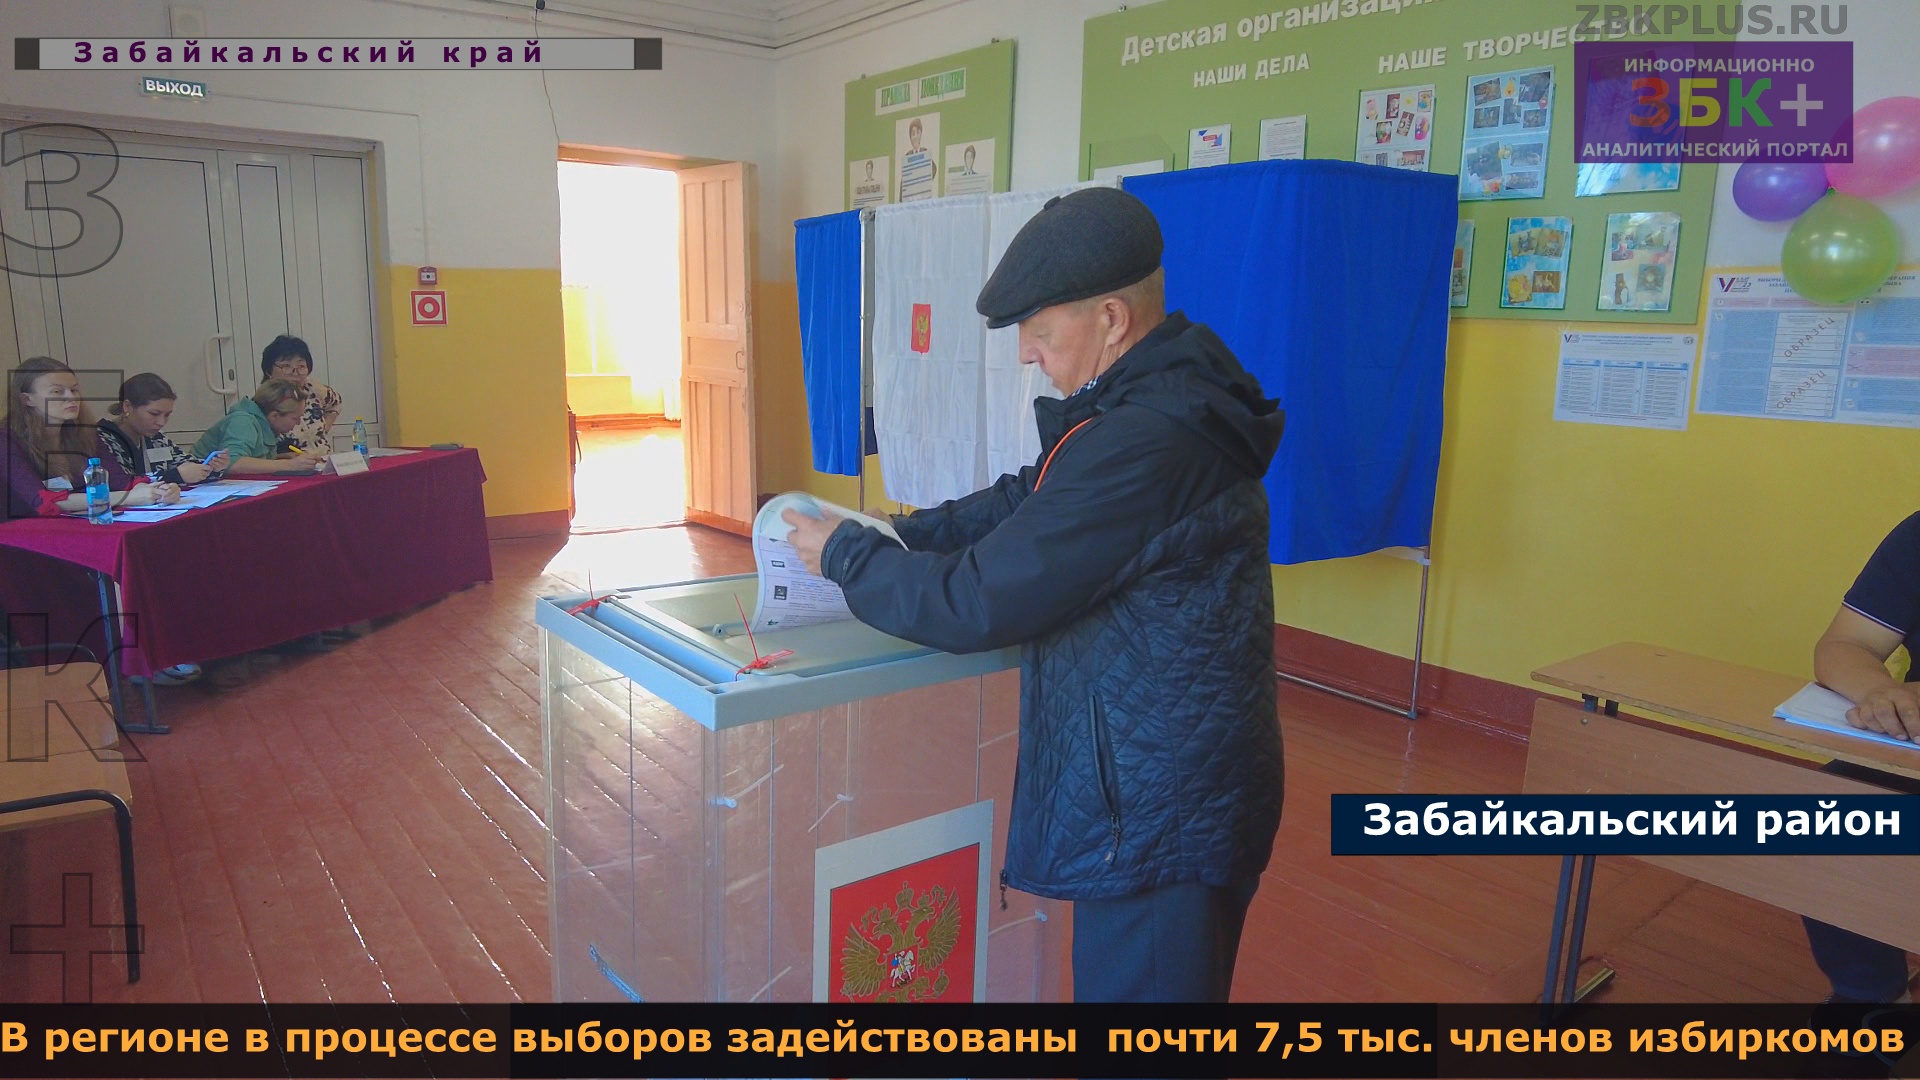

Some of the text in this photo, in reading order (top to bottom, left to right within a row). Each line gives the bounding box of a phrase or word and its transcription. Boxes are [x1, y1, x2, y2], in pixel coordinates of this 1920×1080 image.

[1122, 23, 1227, 65] Детская
[1379, 13, 1650, 74] НАШЕ ТВОРЧЕСТВО
[145, 80, 204, 97] ВЫХОД
[1193, 53, 1310, 88] НАШИ ДЕЛА
[1783, 317, 1835, 358] ОБРАЗЕЦ
[1776, 370, 1826, 409] ОБРАЗЕЦ
